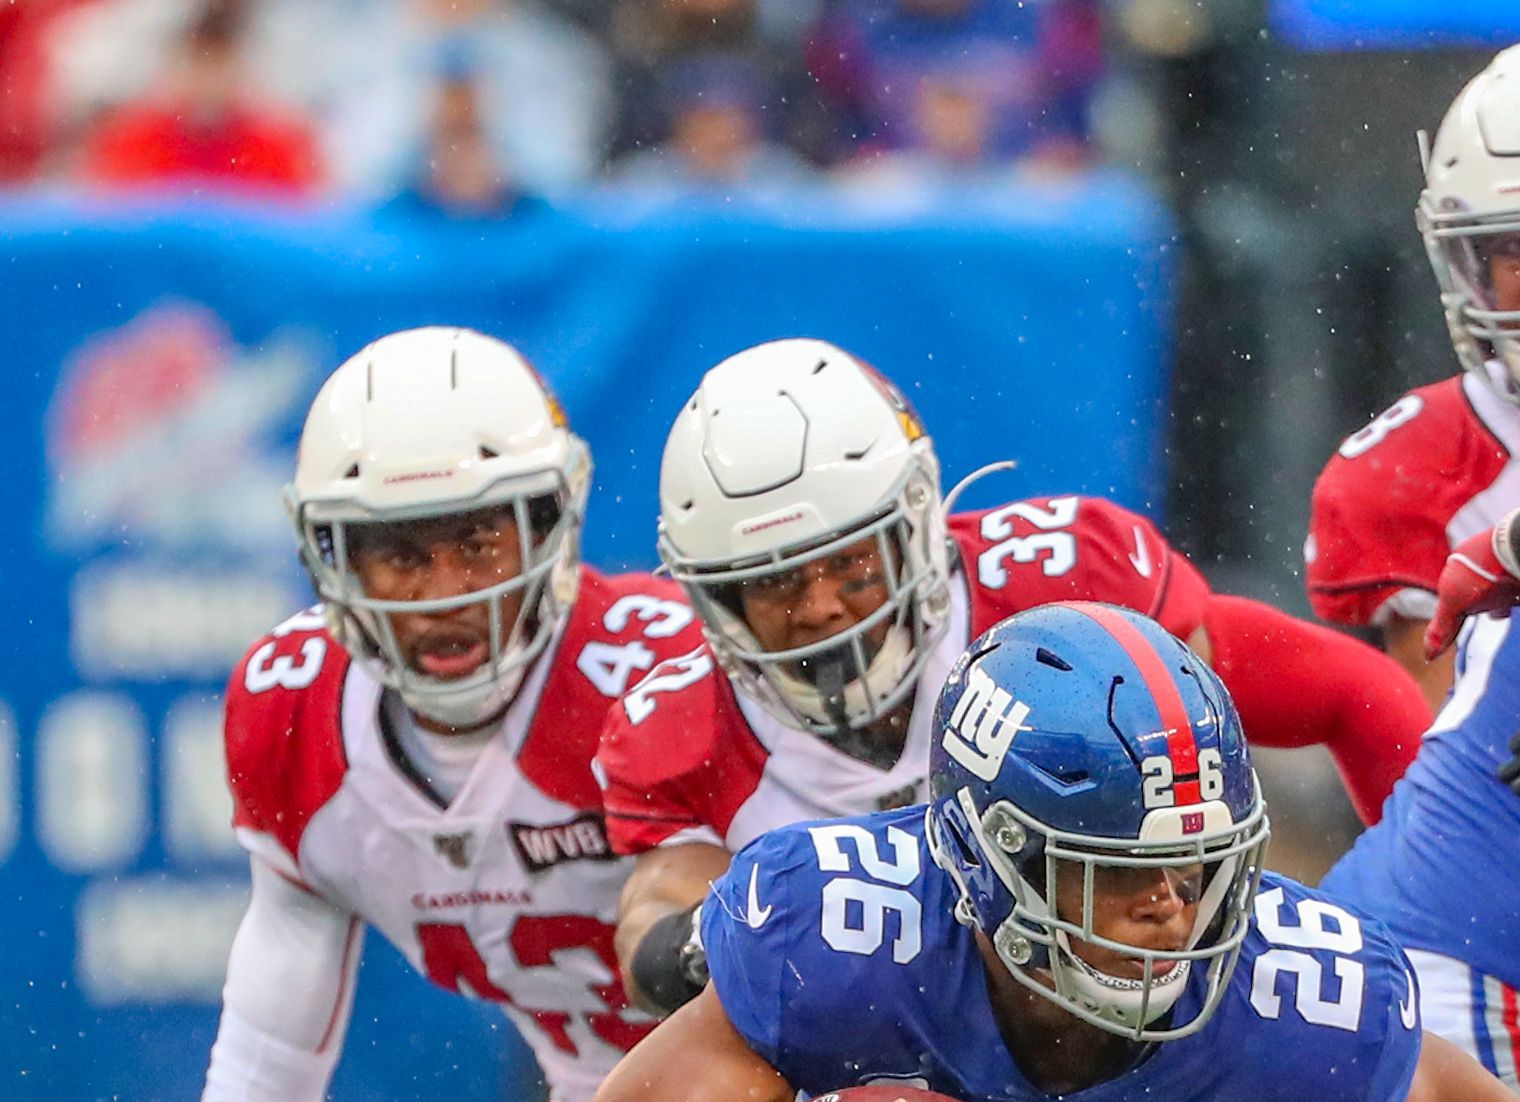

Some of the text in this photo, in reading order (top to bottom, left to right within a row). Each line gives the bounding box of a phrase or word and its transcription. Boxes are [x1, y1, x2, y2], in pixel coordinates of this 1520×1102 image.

[977, 496, 1079, 590] 32
[576, 594, 695, 697] 43
[517, 820, 606, 866] WVB
[807, 824, 922, 965] 26
[1249, 883, 1364, 1033] 26
